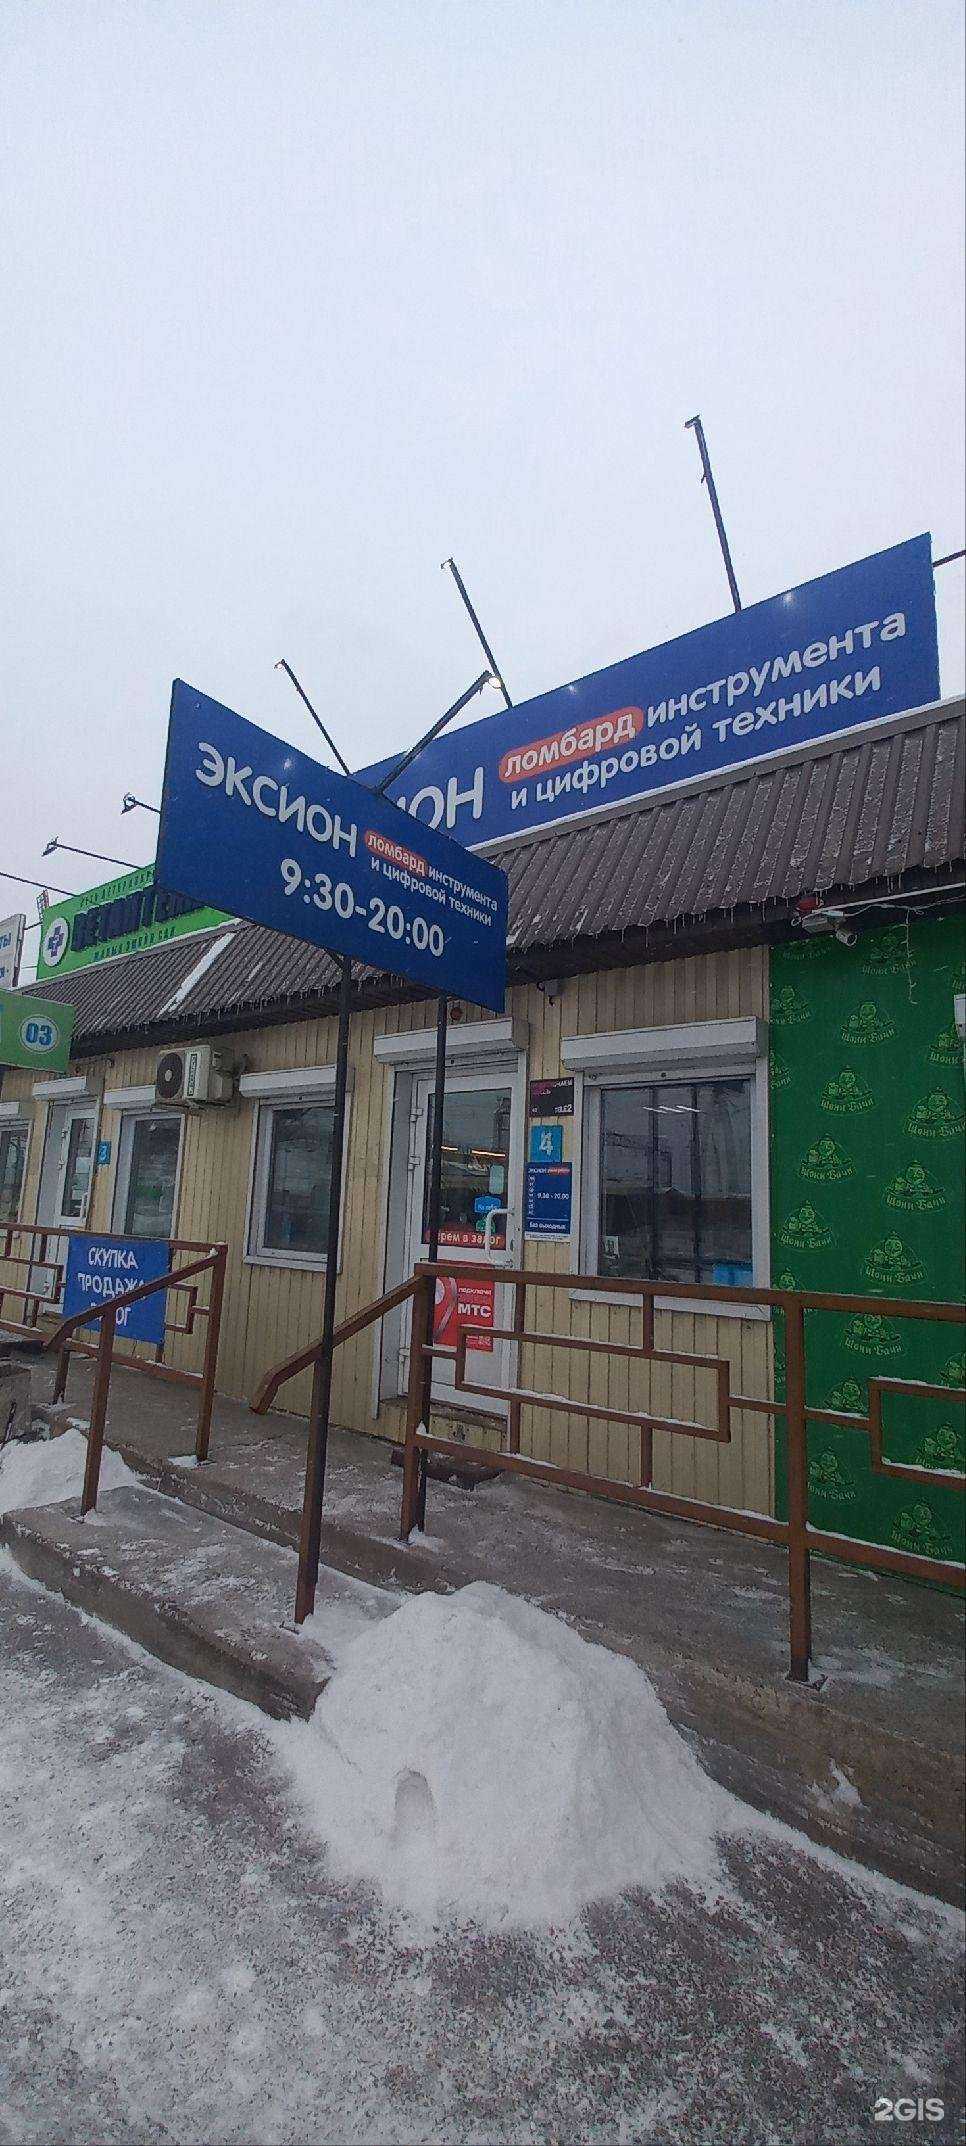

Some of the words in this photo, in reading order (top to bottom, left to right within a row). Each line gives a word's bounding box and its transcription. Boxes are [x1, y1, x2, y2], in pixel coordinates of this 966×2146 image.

[504, 712, 637, 778] ломбард
[647, 611, 906, 728] инструмента
[511, 789, 529, 810] и
[536, 724, 702, 805] цифровой
[711, 666, 882, 740] техники
[195, 742, 357, 858] ЭКСИОН
[280, 858, 445, 957] 9:30-20:00
[367, 832, 427, 877] ломбард
[428, 866, 498, 912] инструмента
[370, 857, 381, 872] и
[383, 862, 447, 905] цифровой
[448, 896, 493, 927] техники
[26, 1023, 52, 1046] 03
[539, 1131, 553, 1157] 4
[88, 1246, 139, 1269] СКУПКА
